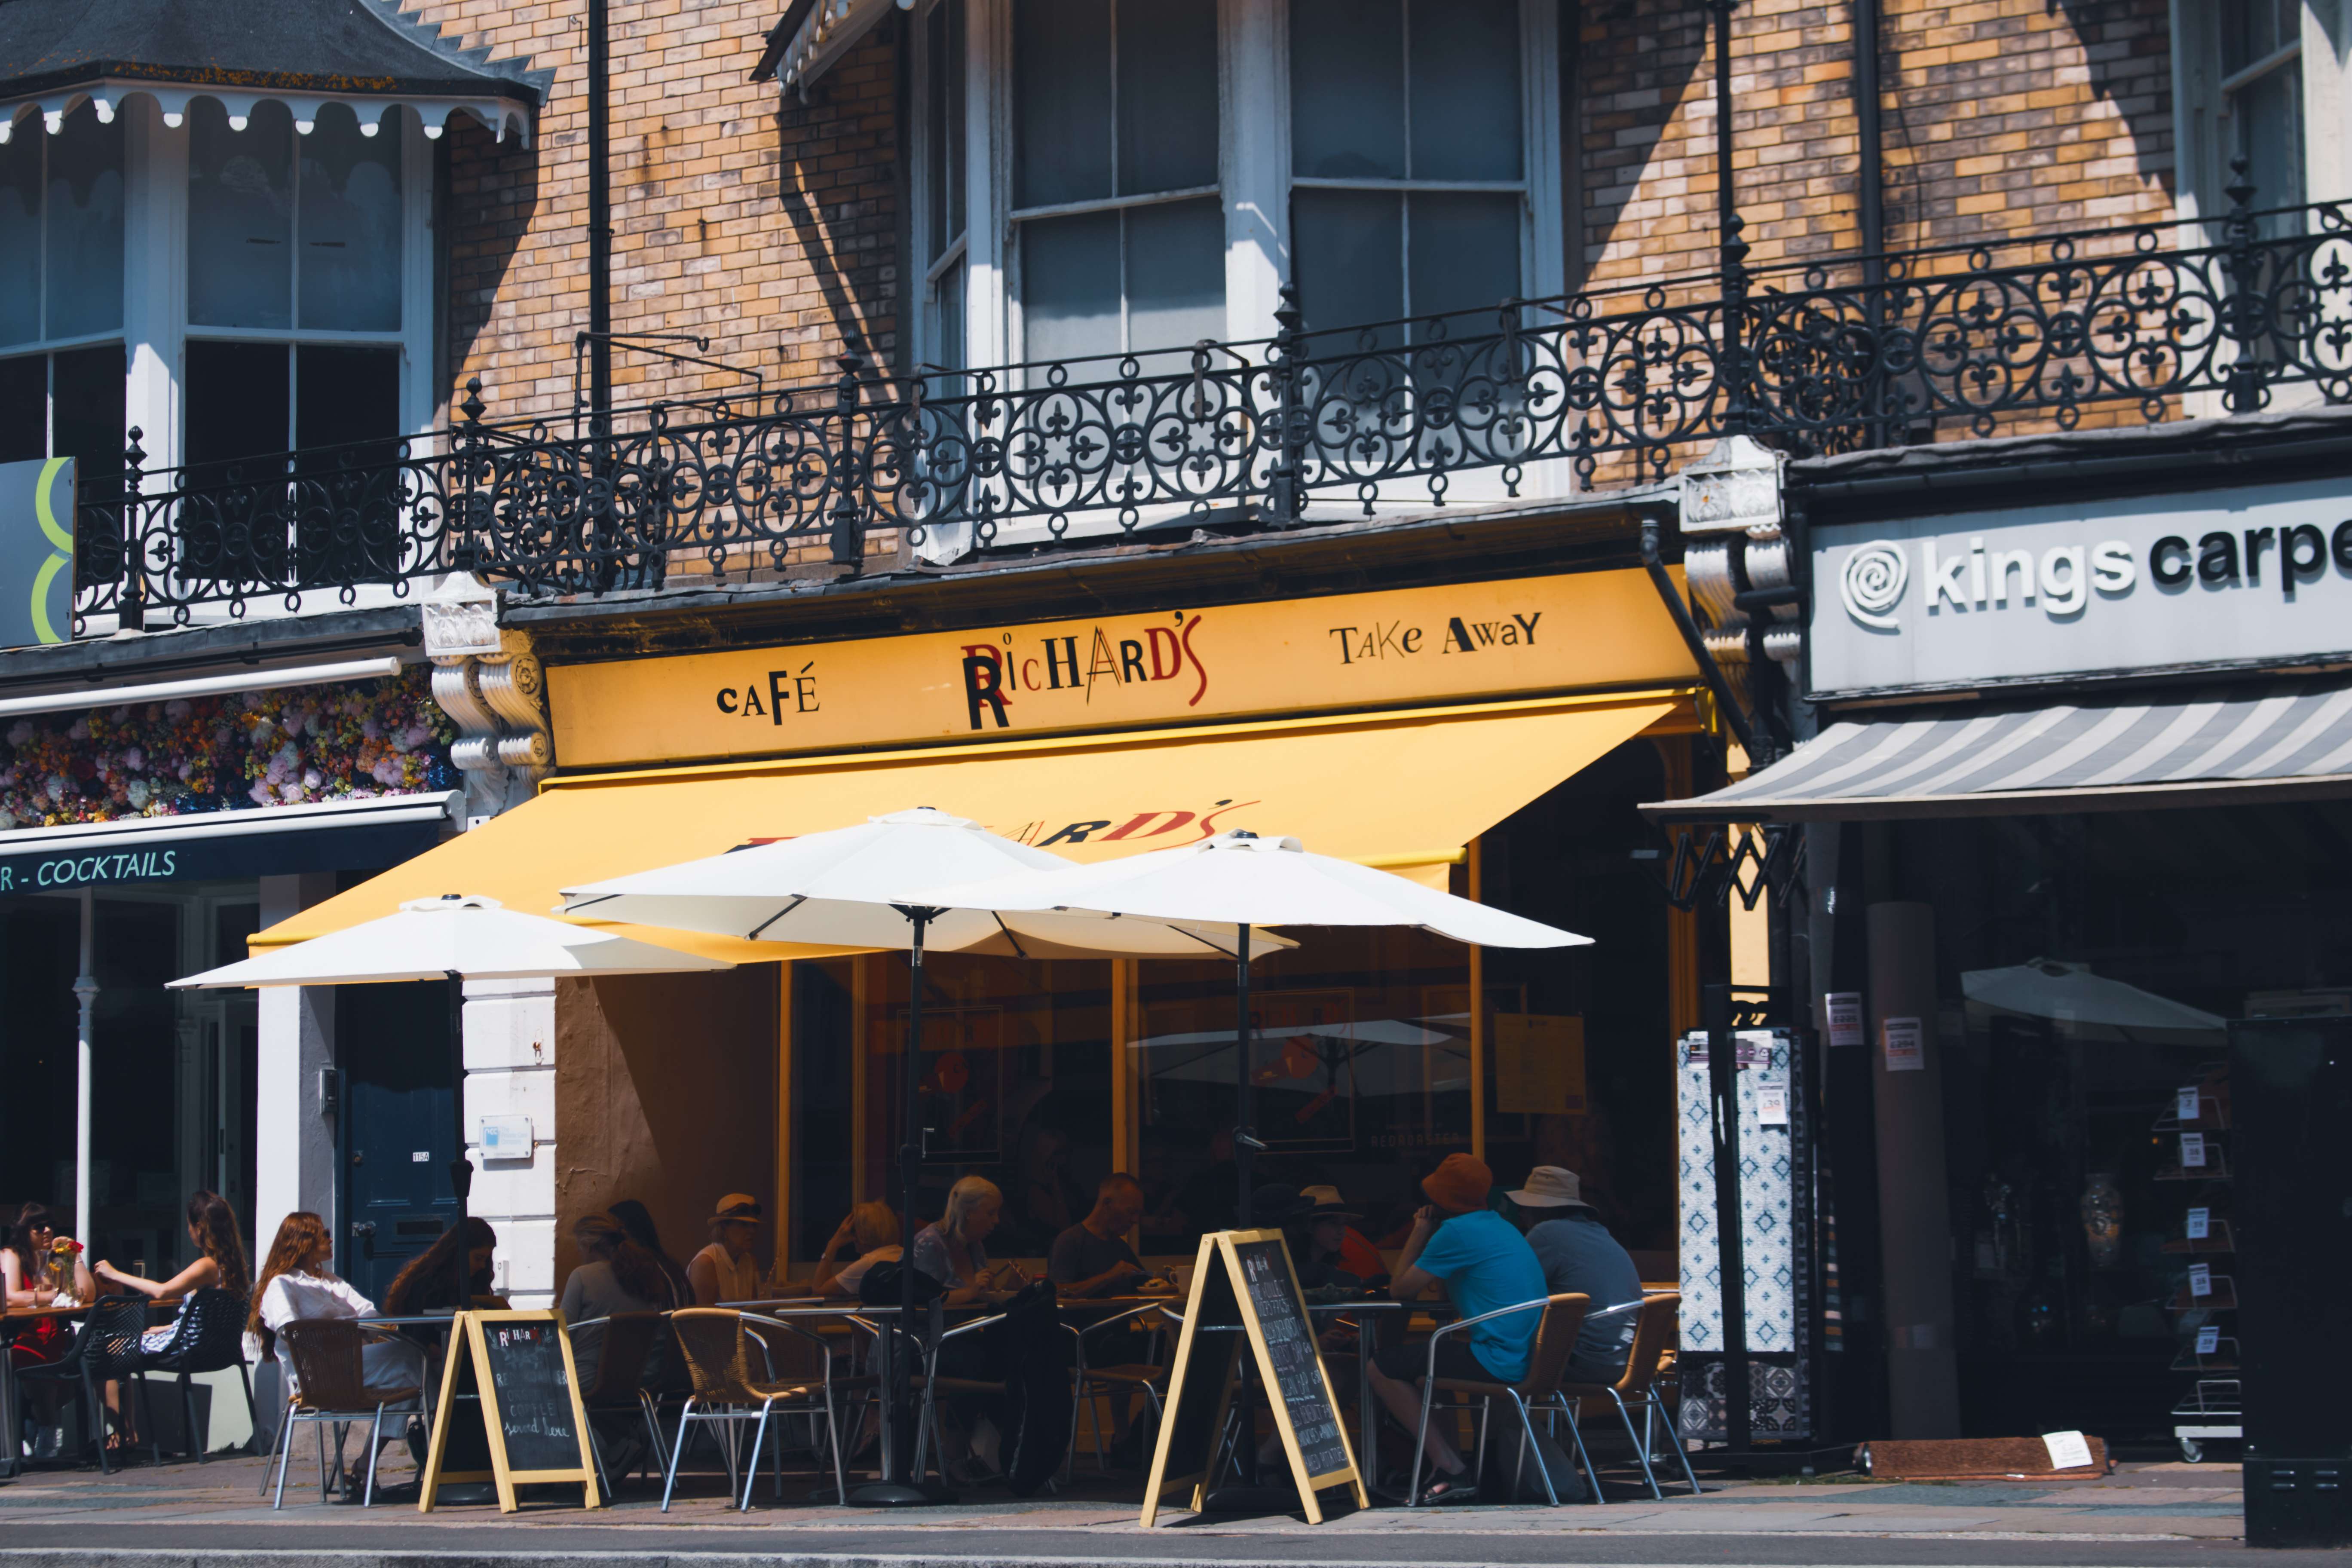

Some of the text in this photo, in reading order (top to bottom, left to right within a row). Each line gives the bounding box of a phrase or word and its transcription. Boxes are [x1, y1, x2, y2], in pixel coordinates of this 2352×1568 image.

[1923, 536, 2136, 614] kings
[37, 850, 176, 886] COCKTAILS
[414, 1153, 429, 1161] 115A
[542, 1416, 570, 1437] here
